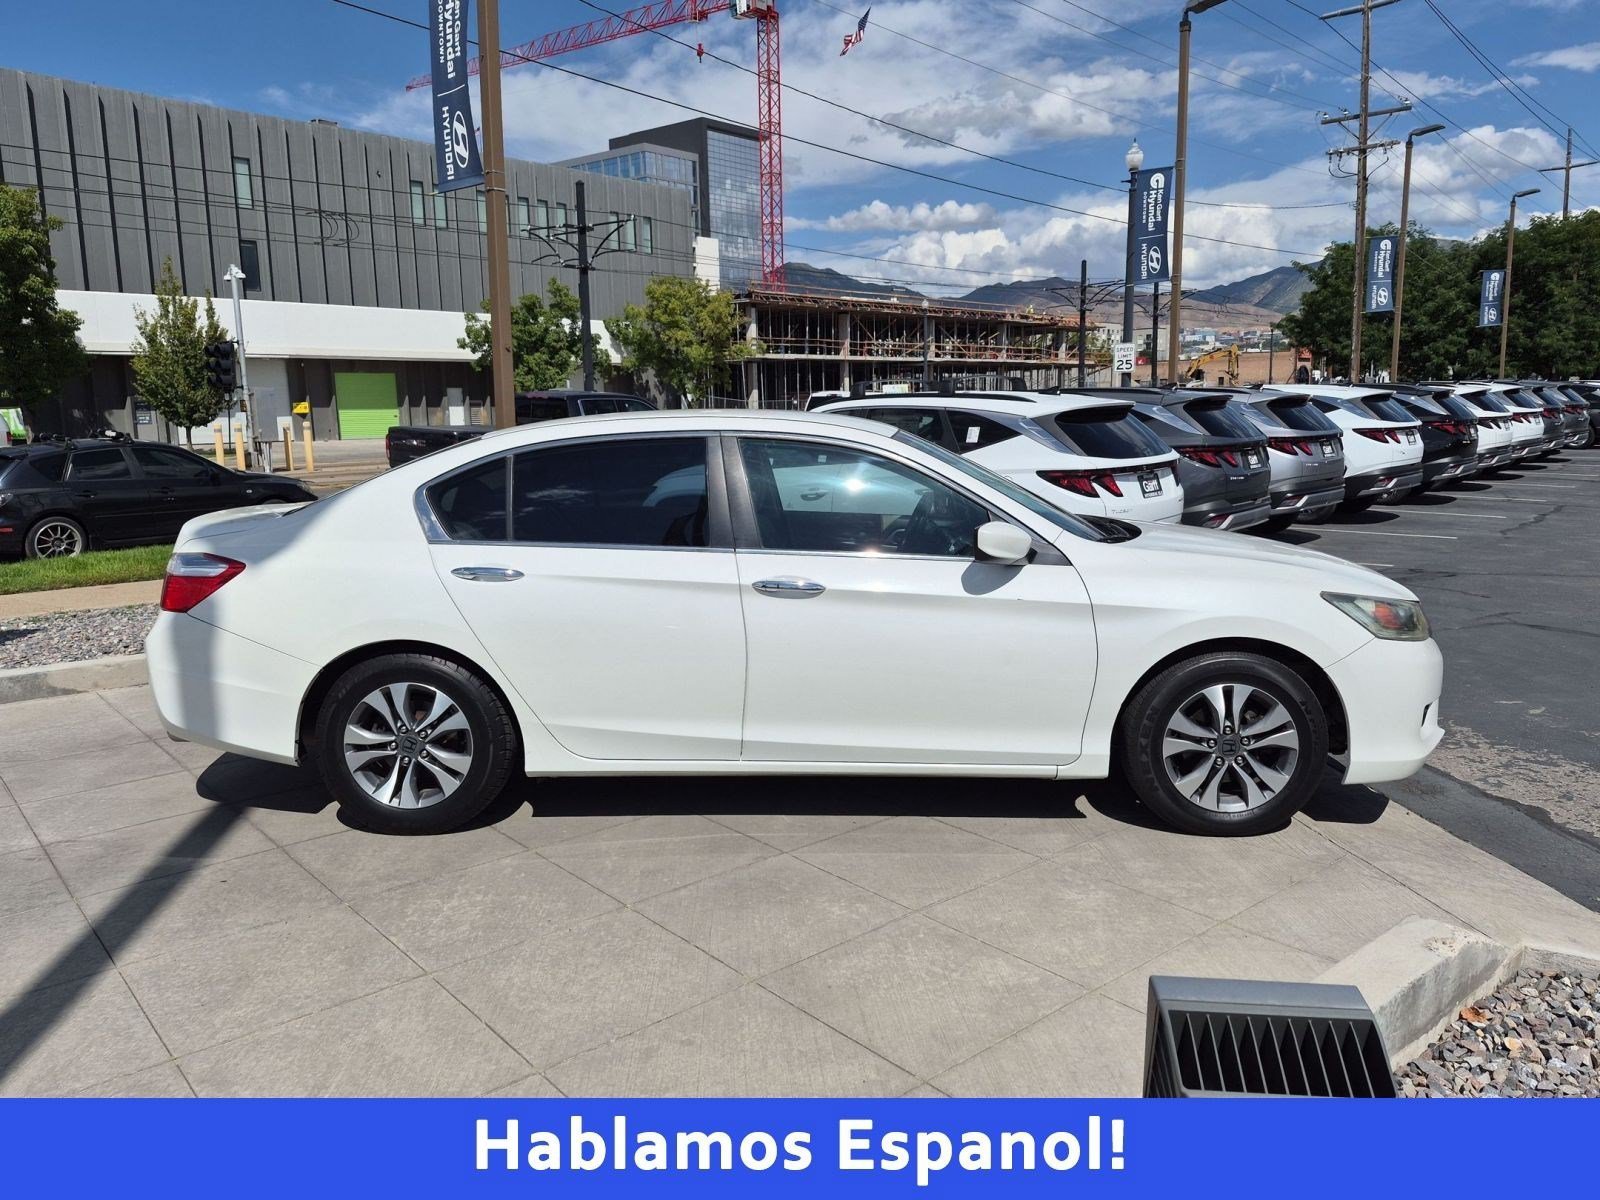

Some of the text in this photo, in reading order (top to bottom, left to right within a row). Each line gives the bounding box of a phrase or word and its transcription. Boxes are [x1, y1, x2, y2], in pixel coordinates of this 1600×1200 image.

[444, 0, 456, 79] Hyundai
[442, 106, 455, 180] HYUNDAI
[1148, 190, 1157, 231] Hyundai
[1116, 360, 1133, 370] 25
